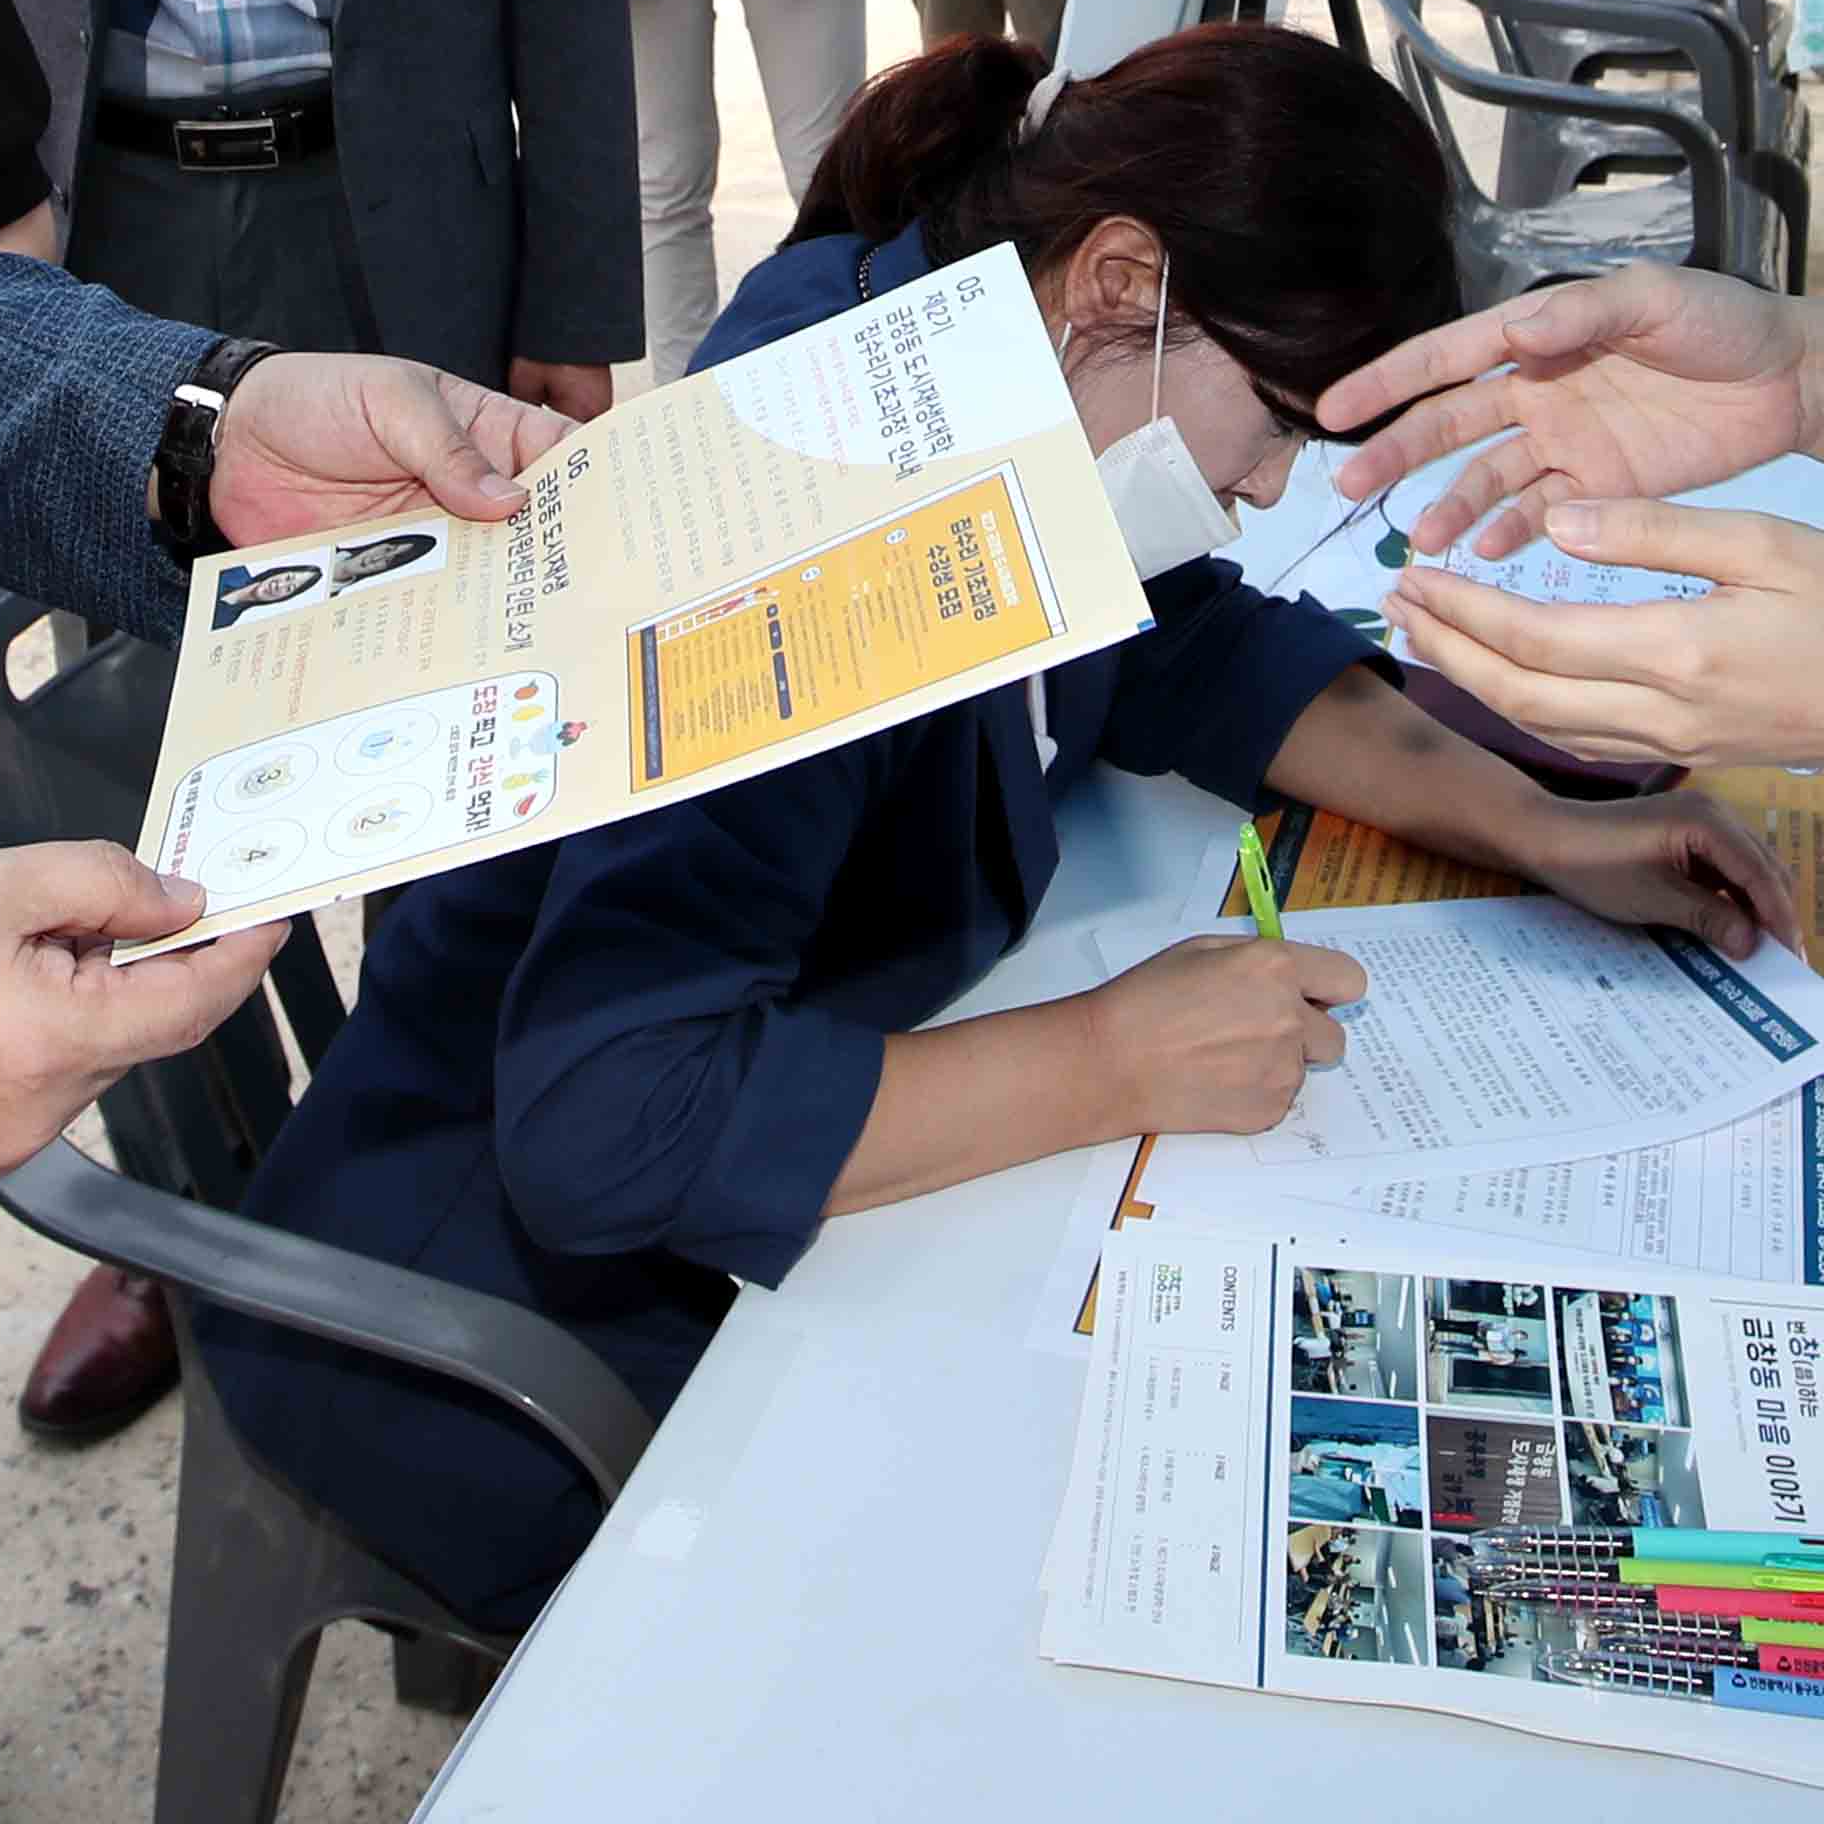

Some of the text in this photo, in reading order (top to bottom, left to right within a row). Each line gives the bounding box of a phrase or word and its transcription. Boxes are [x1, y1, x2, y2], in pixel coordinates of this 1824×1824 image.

[953, 274, 986, 311] 05.
[885, 303, 956, 458] 금창동 도시재생대학
[566, 447, 589, 489] 06.
[886, 439, 923, 482] 안내
[537, 468, 568, 598] 금창동 도시재생
[505, 489, 534, 655] 장지원센터 인턴 소개
[469, 751, 493, 790] 간식
[1221, 1266, 1237, 1331] CONTENTS
[1742, 1318, 1806, 1523] 금창동 마을 이야기
